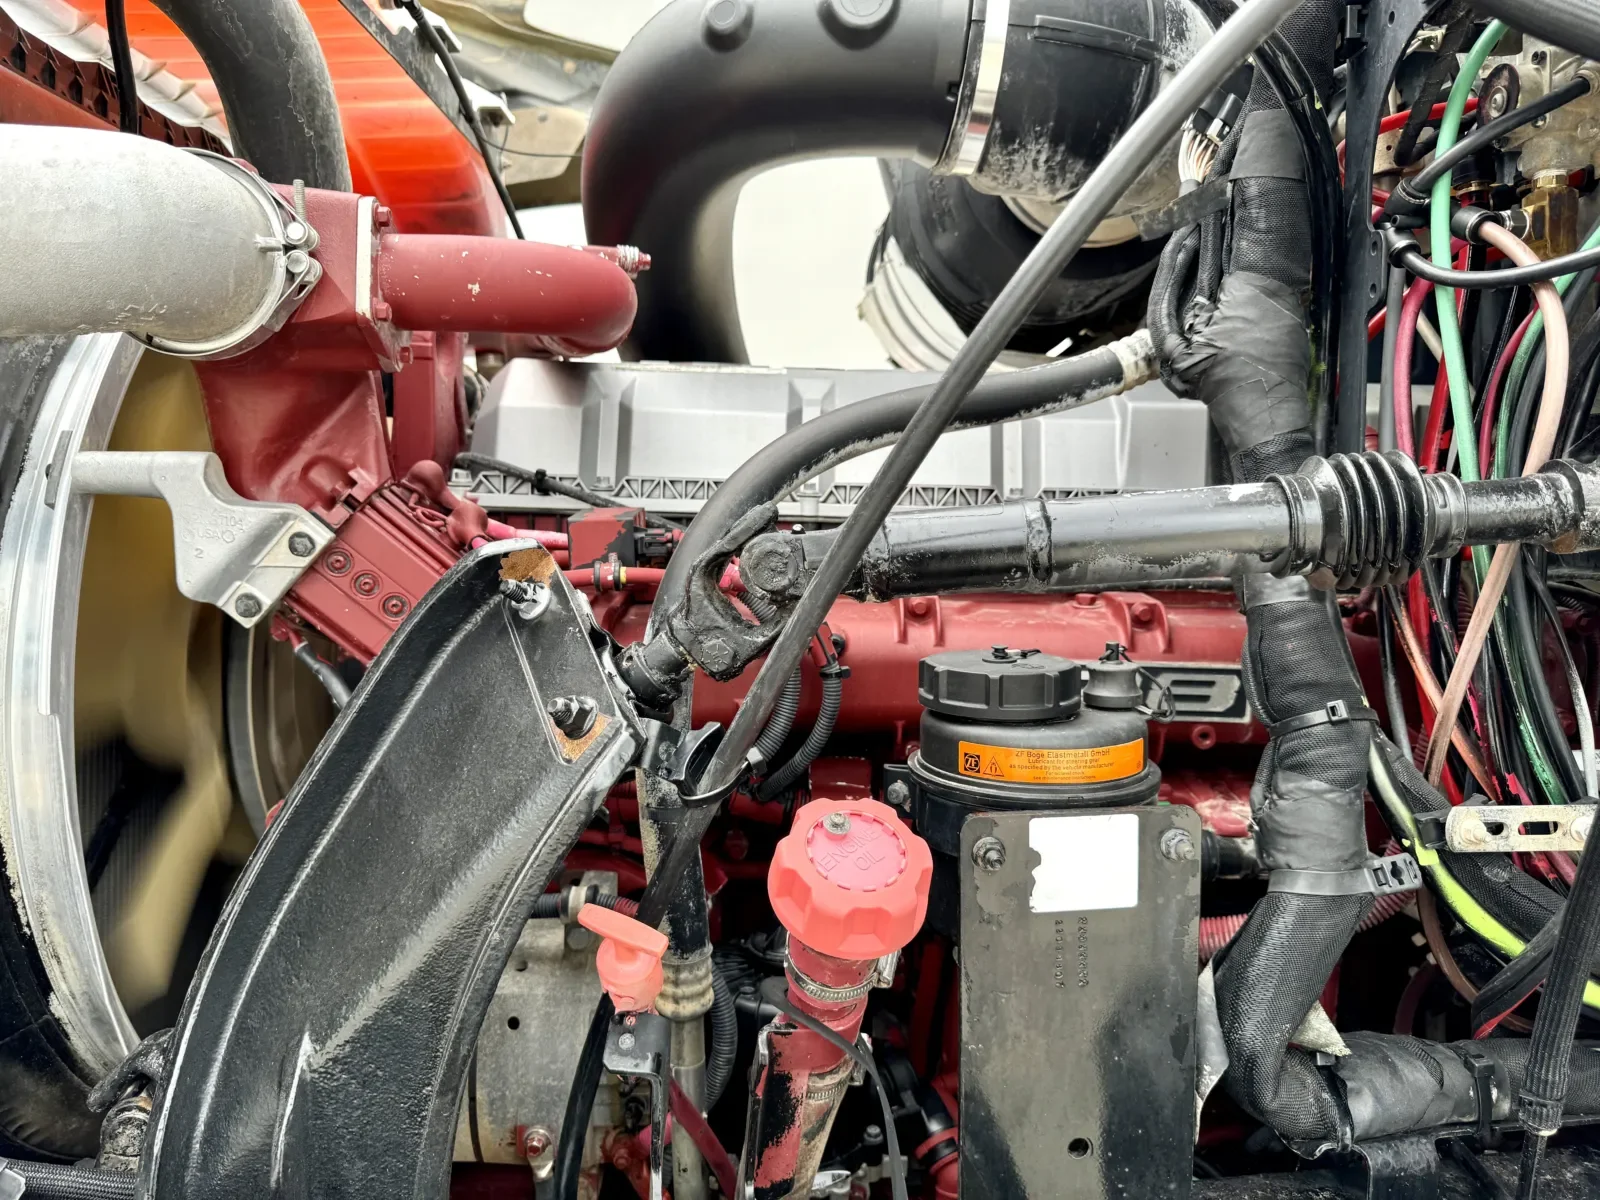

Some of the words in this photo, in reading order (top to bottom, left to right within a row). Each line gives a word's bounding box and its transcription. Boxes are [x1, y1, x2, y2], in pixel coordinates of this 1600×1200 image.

[194, 547, 203, 559] 2
[1027, 751, 1045, 760] Boge
[1047, 751, 1089, 759] Elastmetall
[1091, 749, 1110, 758] GmbH
[1082, 762, 1115, 770] manufacturer
[817, 826, 882, 872] ENGINE
[854, 850, 886, 871] OIL
